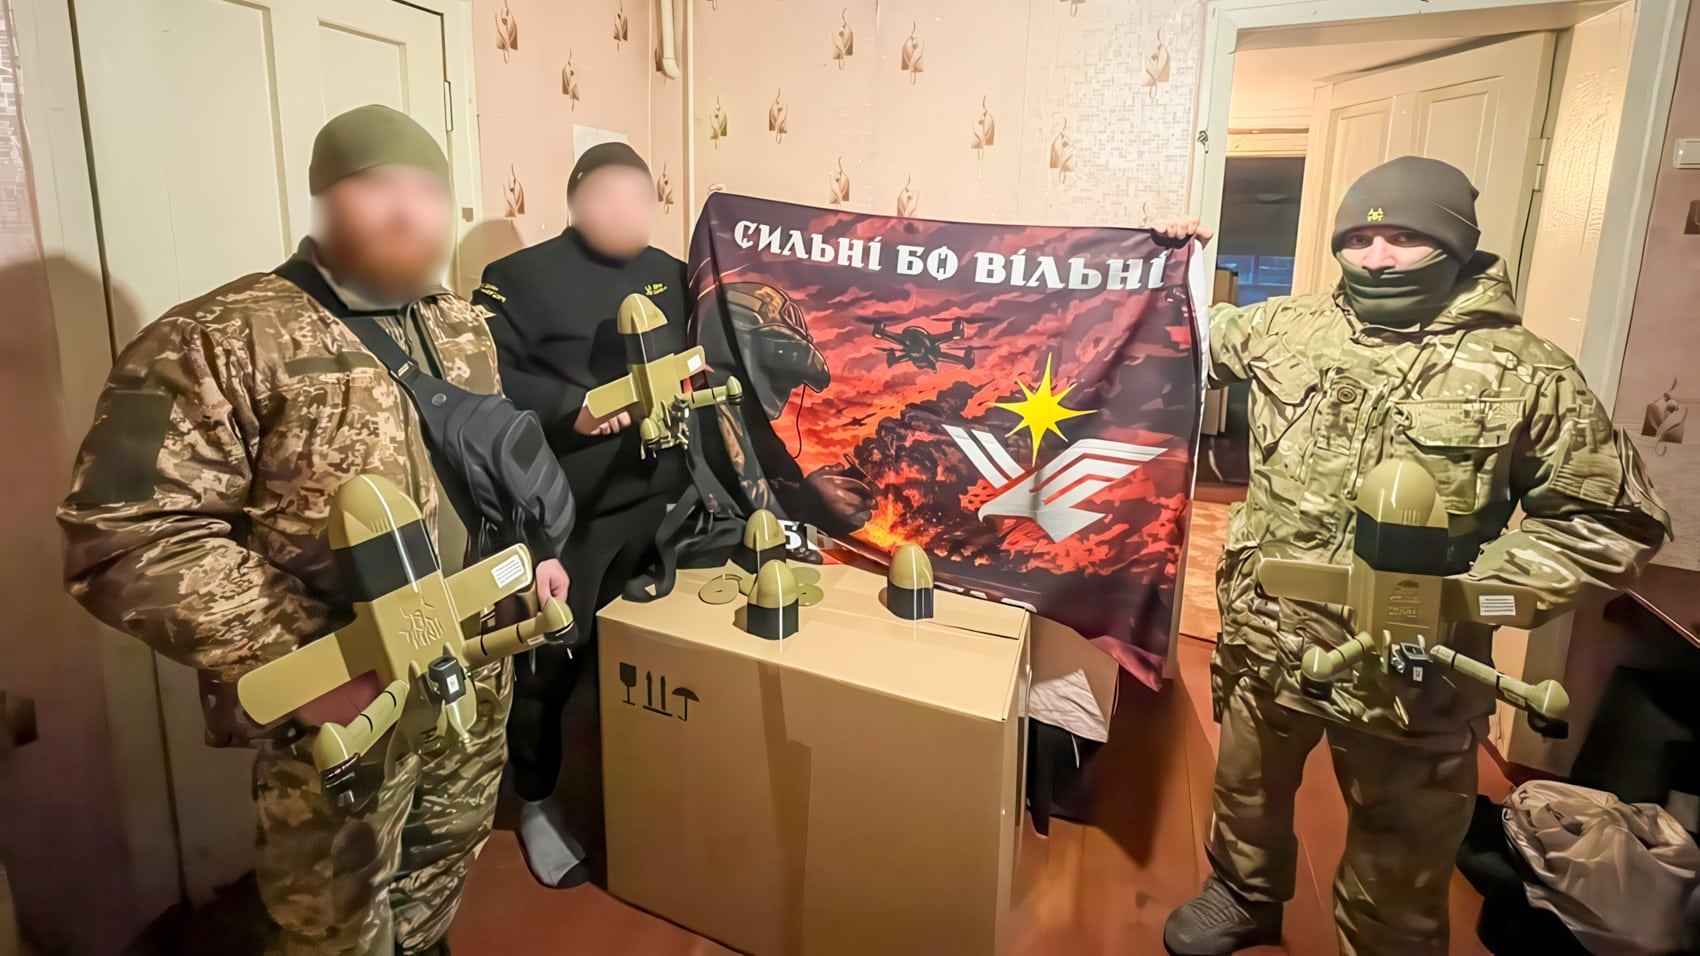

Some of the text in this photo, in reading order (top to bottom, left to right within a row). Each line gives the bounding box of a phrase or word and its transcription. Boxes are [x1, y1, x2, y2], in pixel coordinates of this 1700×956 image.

[734, 220, 1169, 290] СИЛЬНІ БО ВІЛЬНІ
